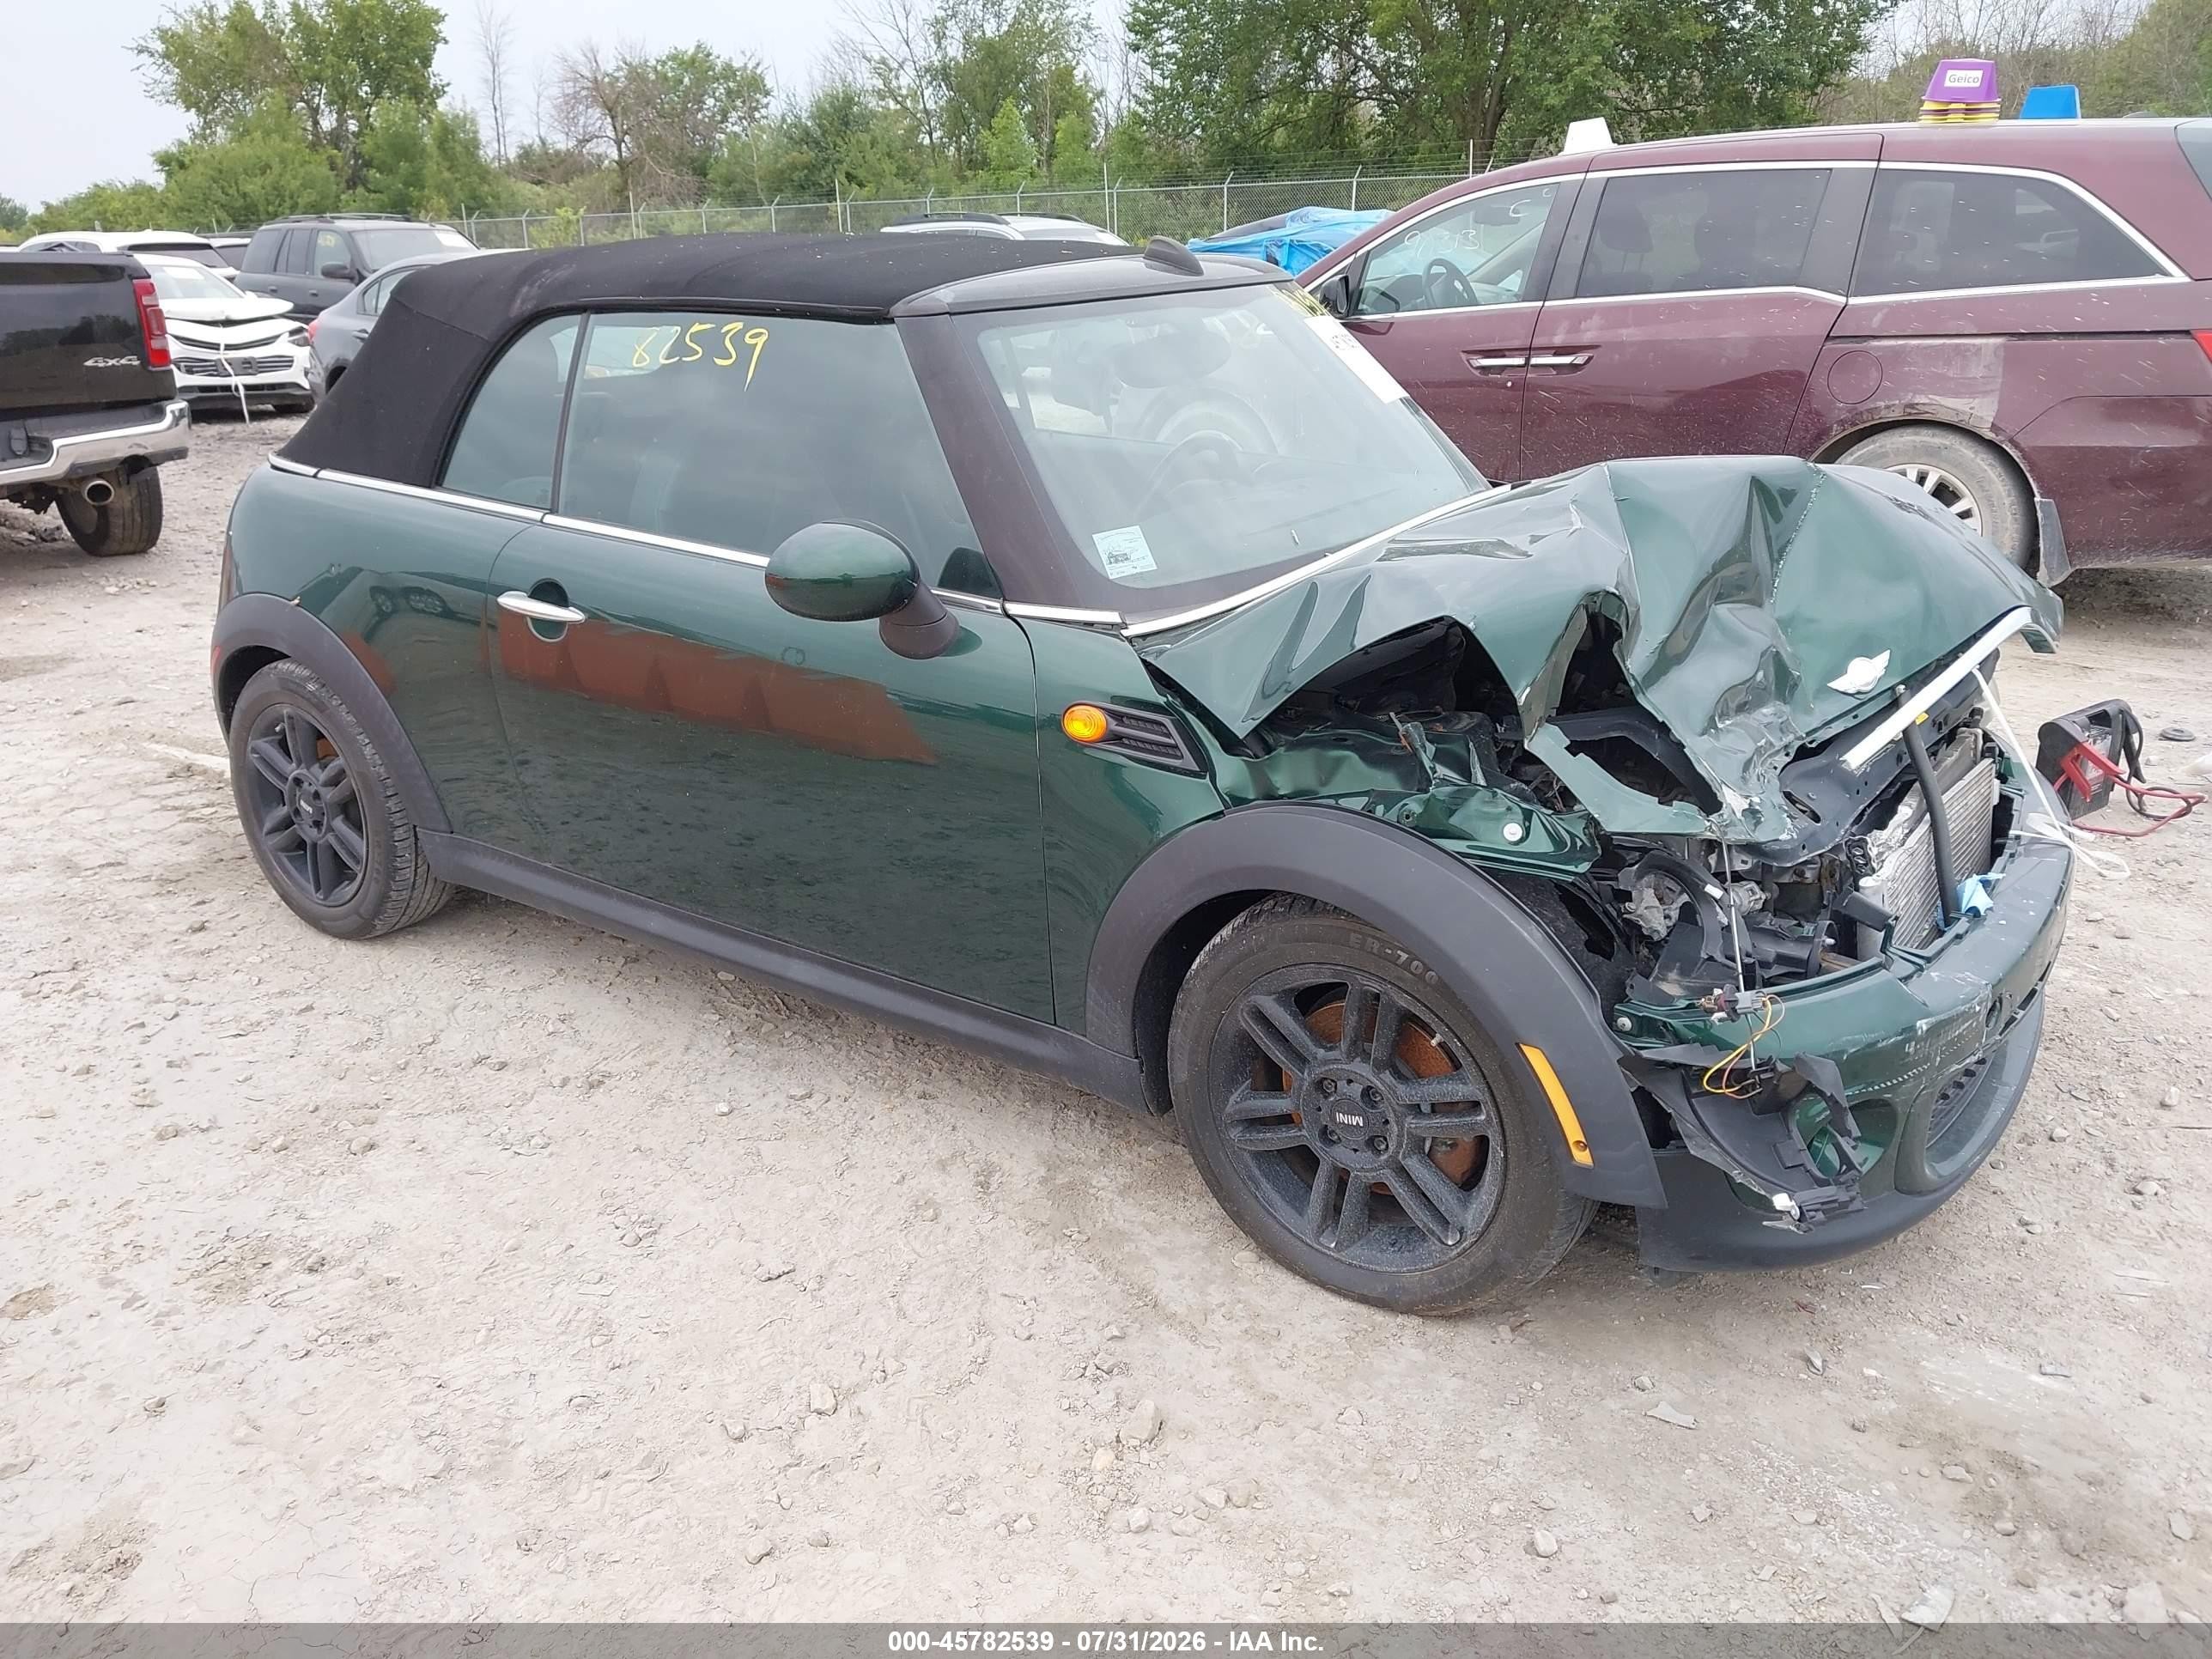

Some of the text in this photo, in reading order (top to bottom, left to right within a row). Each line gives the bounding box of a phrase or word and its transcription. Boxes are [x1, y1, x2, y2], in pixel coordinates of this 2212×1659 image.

[1948, 74, 1979, 83] Geico
[633, 321, 769, 392] 82539
[1349, 933, 1439, 985] ER-700
[1335, 1111, 1364, 1127] MINI
